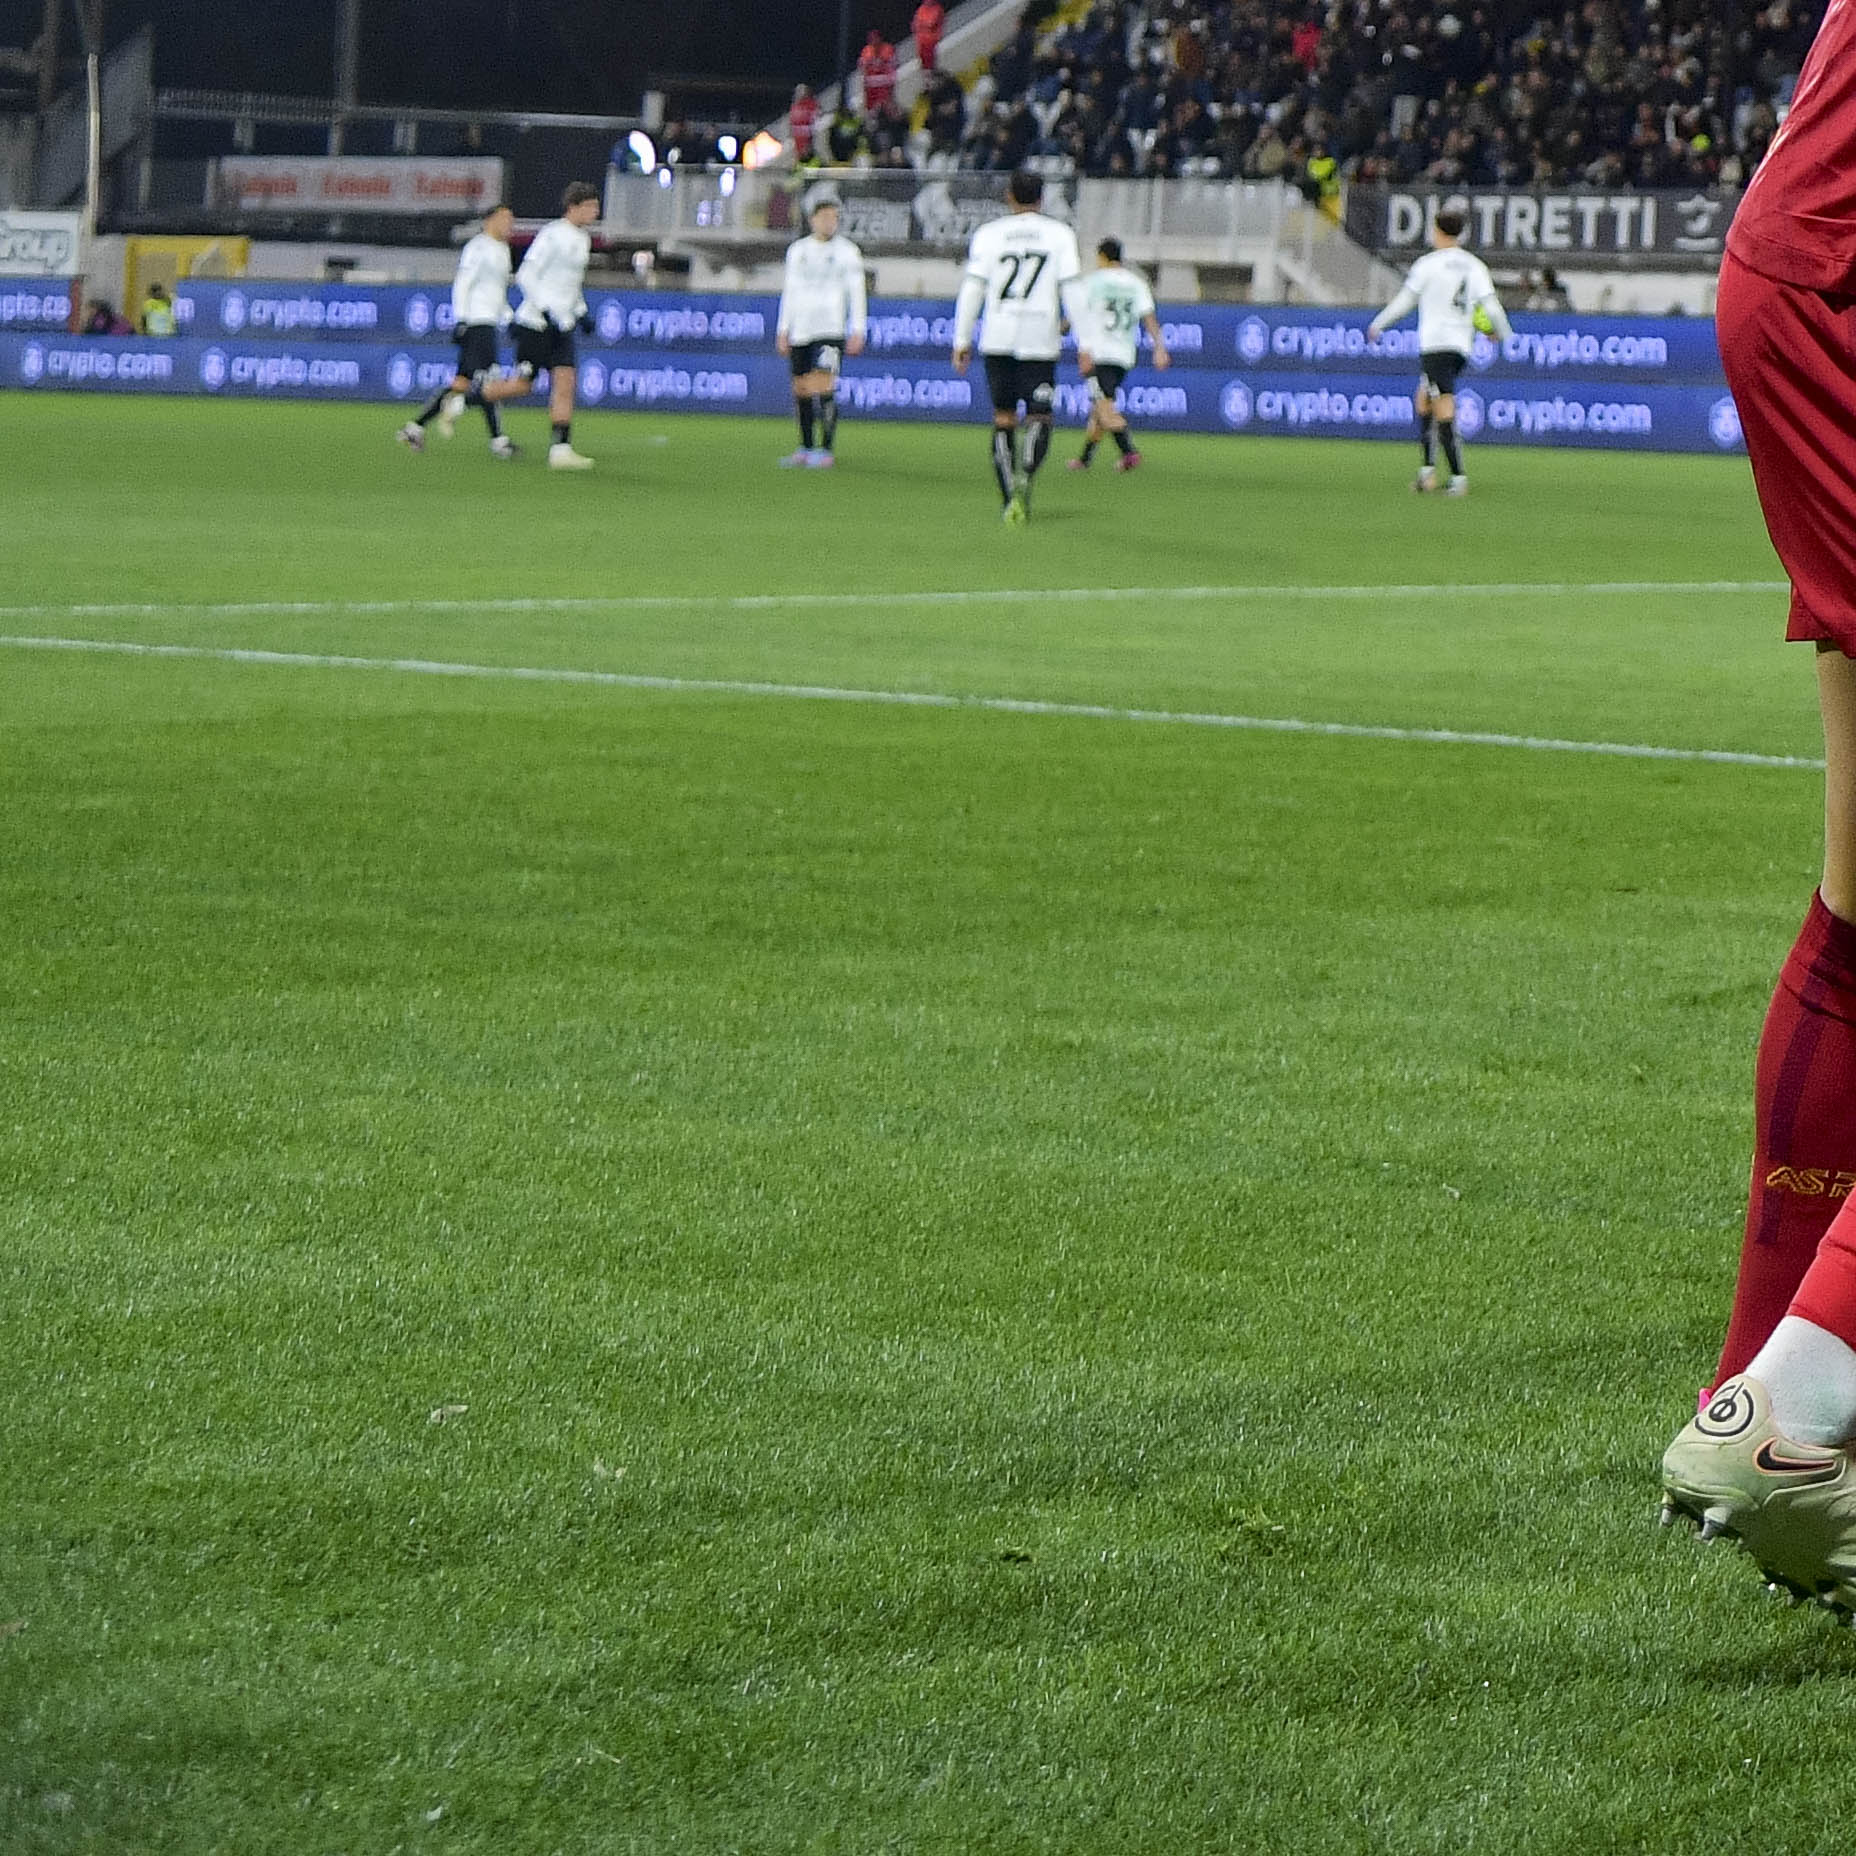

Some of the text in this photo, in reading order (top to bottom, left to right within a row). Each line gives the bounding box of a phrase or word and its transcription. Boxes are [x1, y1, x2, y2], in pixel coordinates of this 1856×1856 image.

[1000, 251, 1049, 301] 27
[250, 297, 378, 329] crypto.com
[1451, 275, 1468, 315] 4
[628, 307, 765, 338] crypto.com
[47, 347, 173, 380] crypto.com
[231, 352, 360, 387] crypto.com
[611, 366, 748, 402] crypto.com
[1256, 389, 1413, 426] crypto.com
[1489, 397, 1652, 435] crypto.com
